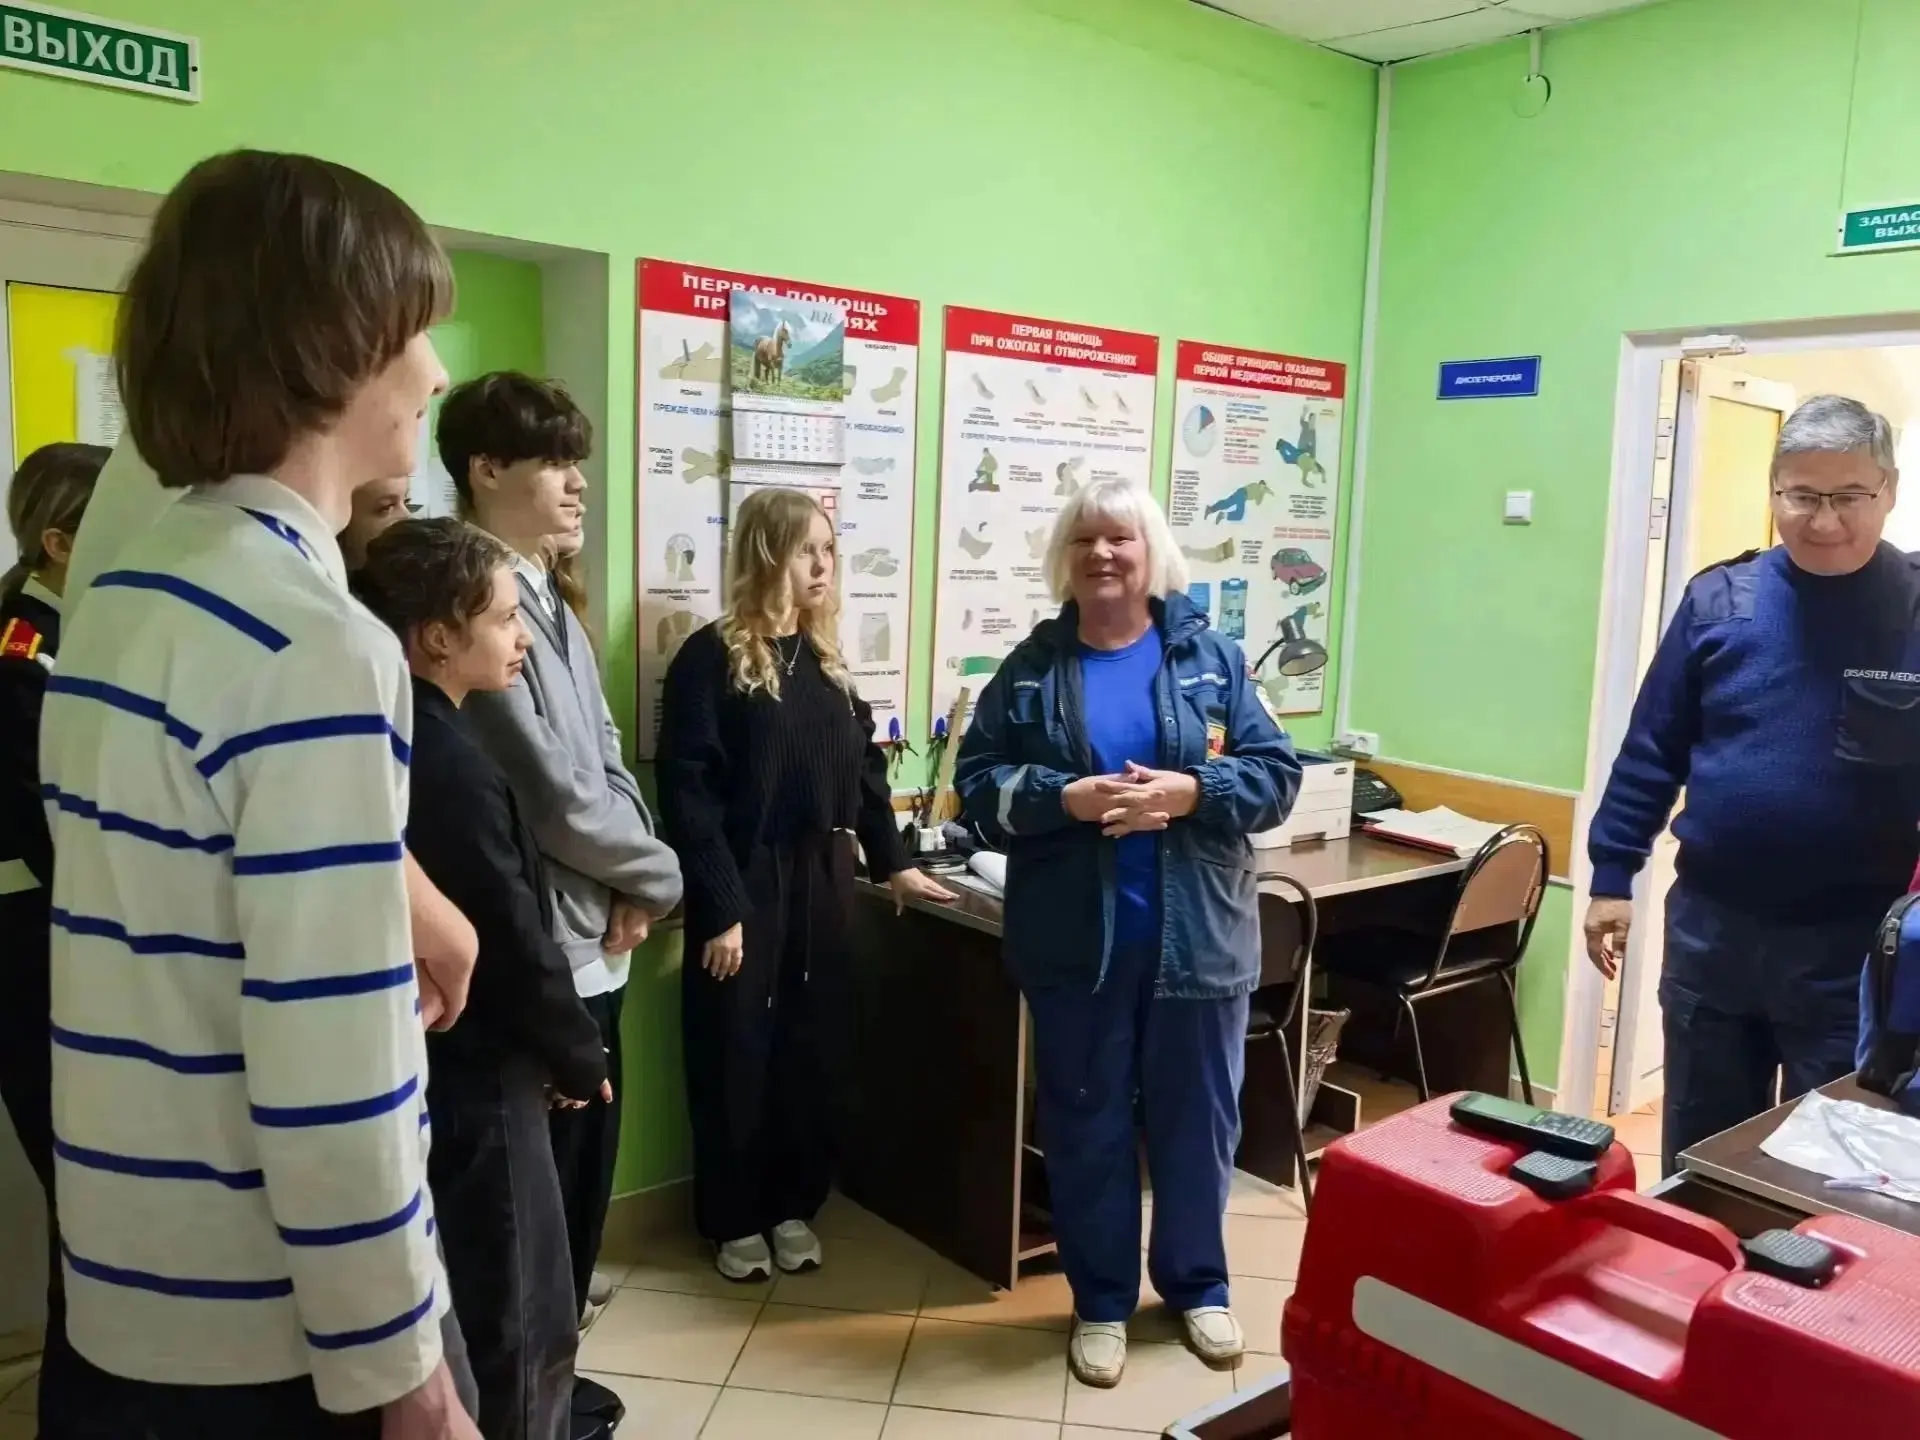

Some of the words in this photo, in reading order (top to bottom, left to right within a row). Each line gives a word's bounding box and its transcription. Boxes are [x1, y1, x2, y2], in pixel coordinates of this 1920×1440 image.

[4, 14, 180, 88] ВЫХОД
[1875, 223, 1920, 238] ВЫХ
[693, 294, 727, 311] ПР
[1011, 323, 1053, 341] ПЕРВАЯ
[1056, 330, 1103, 348] ПОМОЩЬ
[971, 333, 994, 348] ПРИ
[997, 338, 1041, 354] ОЖОГАХ
[1043, 344, 1052, 356] И
[1054, 346, 1138, 367] ОТМОРОЖЕНИЯХ
[1202, 351, 1236, 366] ОБЩИЕ
[1236, 355, 1283, 372] ПРИНЦИПЫ
[1193, 364, 1229, 378] ПЕРВОЙ
[1230, 369, 1294, 386] МЕДИЦИНСКОЙ
[1294, 377, 1332, 392] ПОМОЩИ
[1455, 373, 1523, 385] ДИСПЕТЧЕРСКАЯ
[1843, 668, 1889, 680] DISASTER
